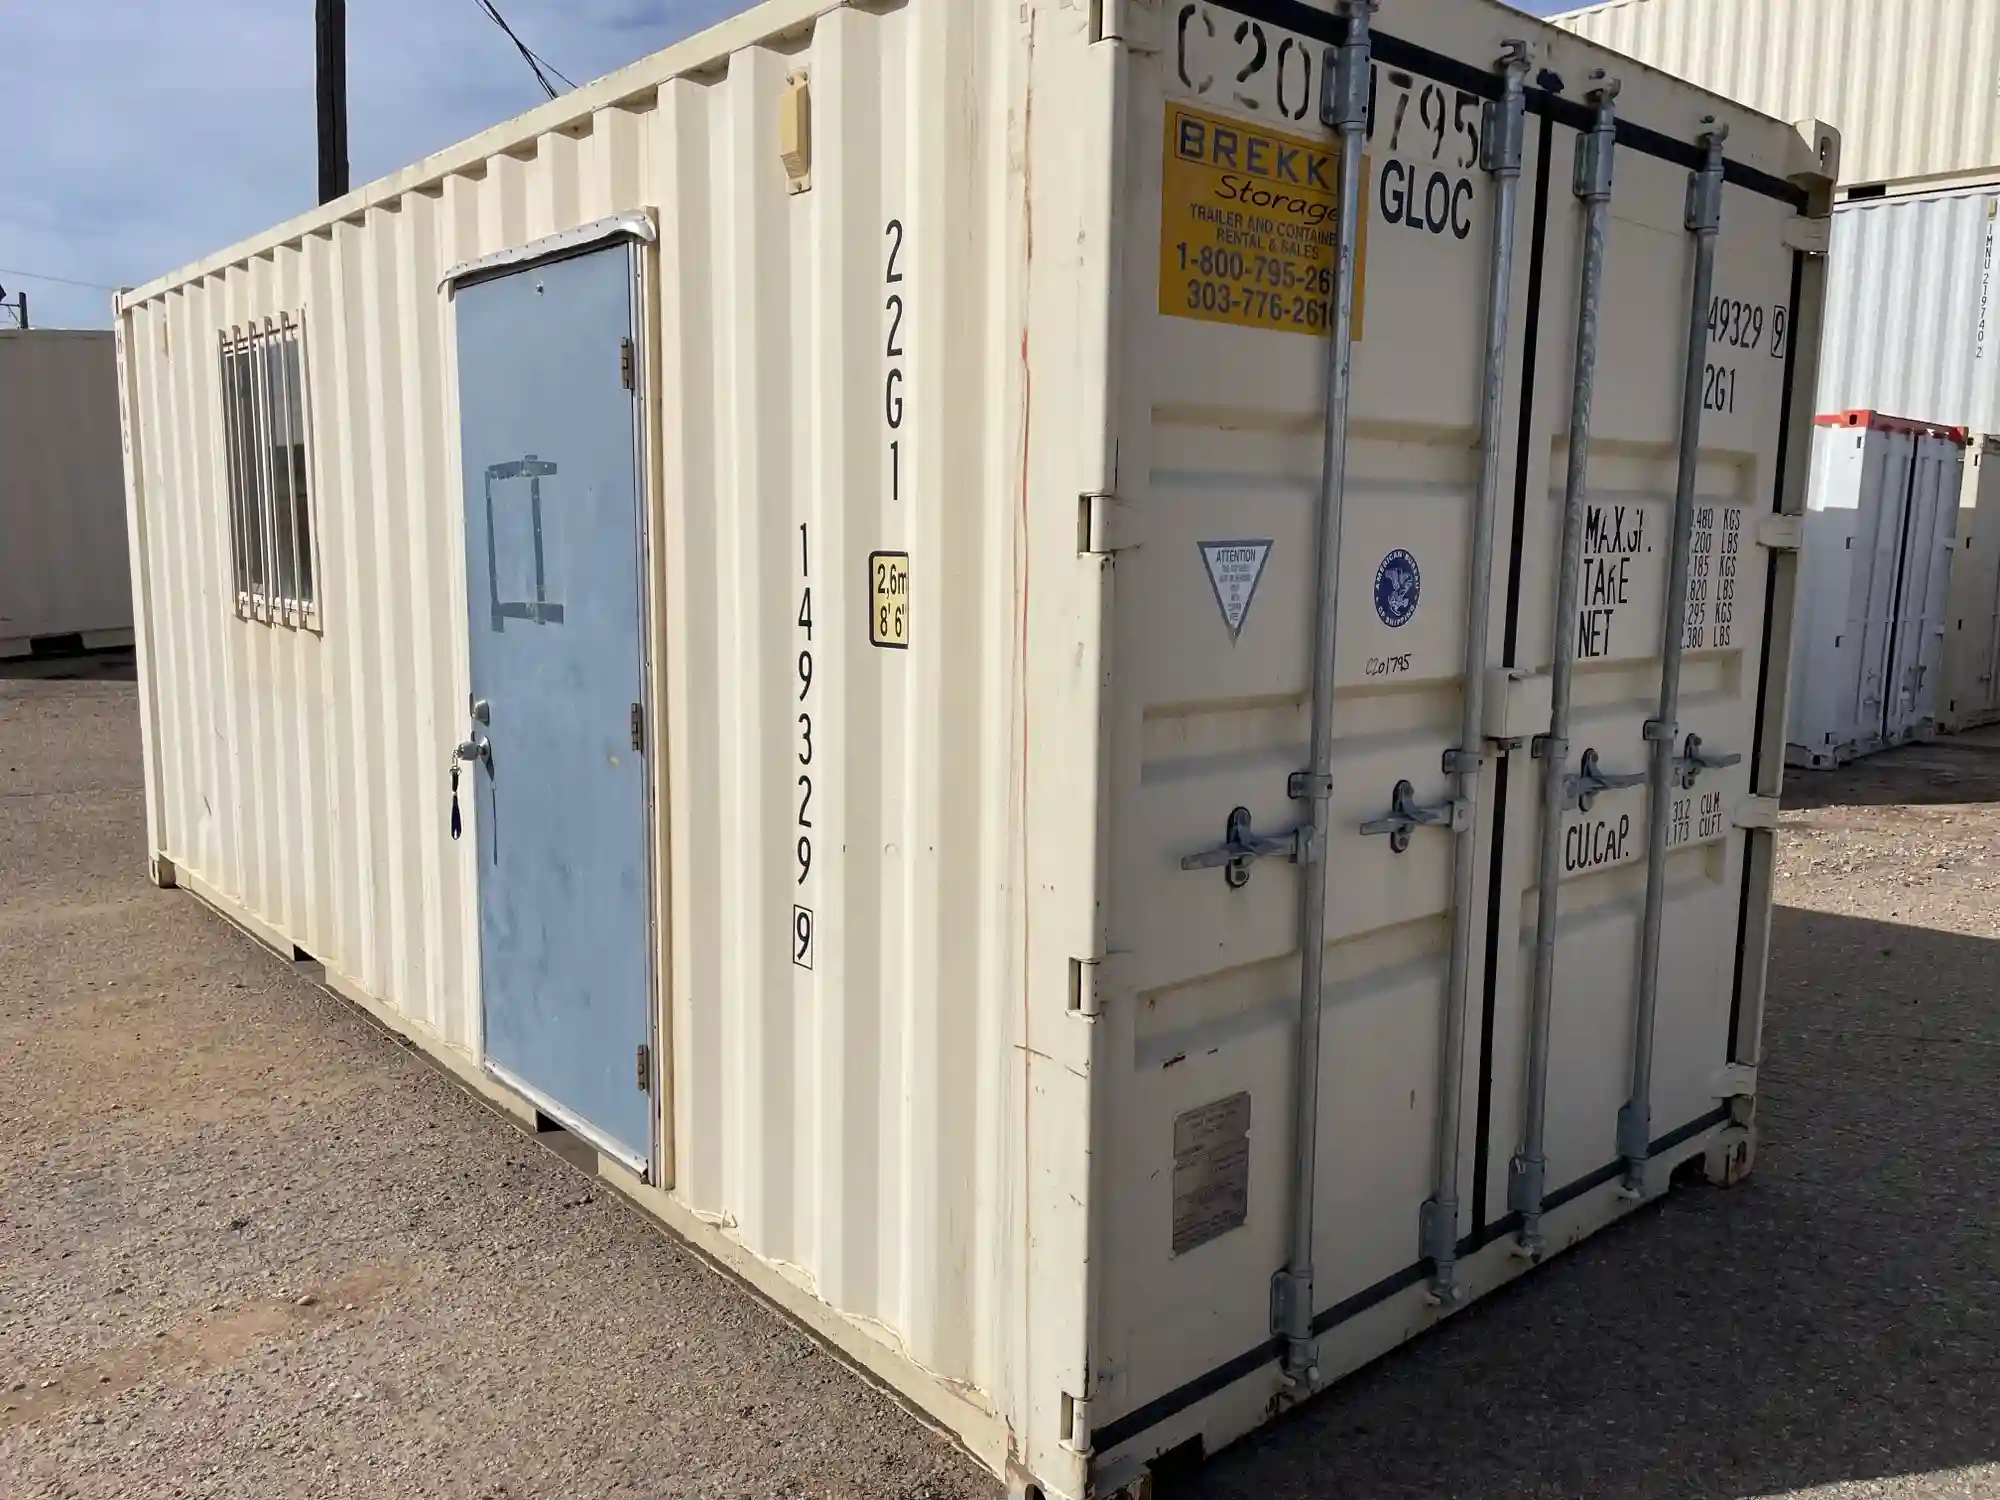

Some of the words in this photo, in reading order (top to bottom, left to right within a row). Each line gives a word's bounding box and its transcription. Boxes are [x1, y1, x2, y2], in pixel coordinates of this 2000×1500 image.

[1180, 119, 1331, 190] BREKK
[1215, 174, 1337, 225] Storage
[1380, 159, 1473, 239] GLOC
[1190, 203, 1243, 229] TRAILER
[1248, 215, 1273, 234] AND
[1276, 222, 1337, 247] CONTAINE
[1216, 227, 1263, 249] RENTAL
[1268, 238, 1278, 252] &
[1281, 241, 1319, 260] SALES
[1176, 241, 1337, 297] 1-800-795-261
[1707, 296, 1763, 349] 49329
[1772, 307, 1786, 356] 9
[885, 218, 903, 501] 22G1
[1704, 363, 1735, 413] 2G1
[1721, 531, 1739, 554] LBS
[1723, 508, 1741, 531] KGS
[1216, 548, 1256, 563] ATTENTION
[1719, 555, 1737, 578] KGS
[1716, 579, 1734, 601] LBS
[1577, 609, 1614, 658] NET
[1715, 601, 1733, 624] KGS
[1713, 624, 1731, 648] LBS
[797, 522, 813, 886] 149329
[795, 909, 812, 963] 9
